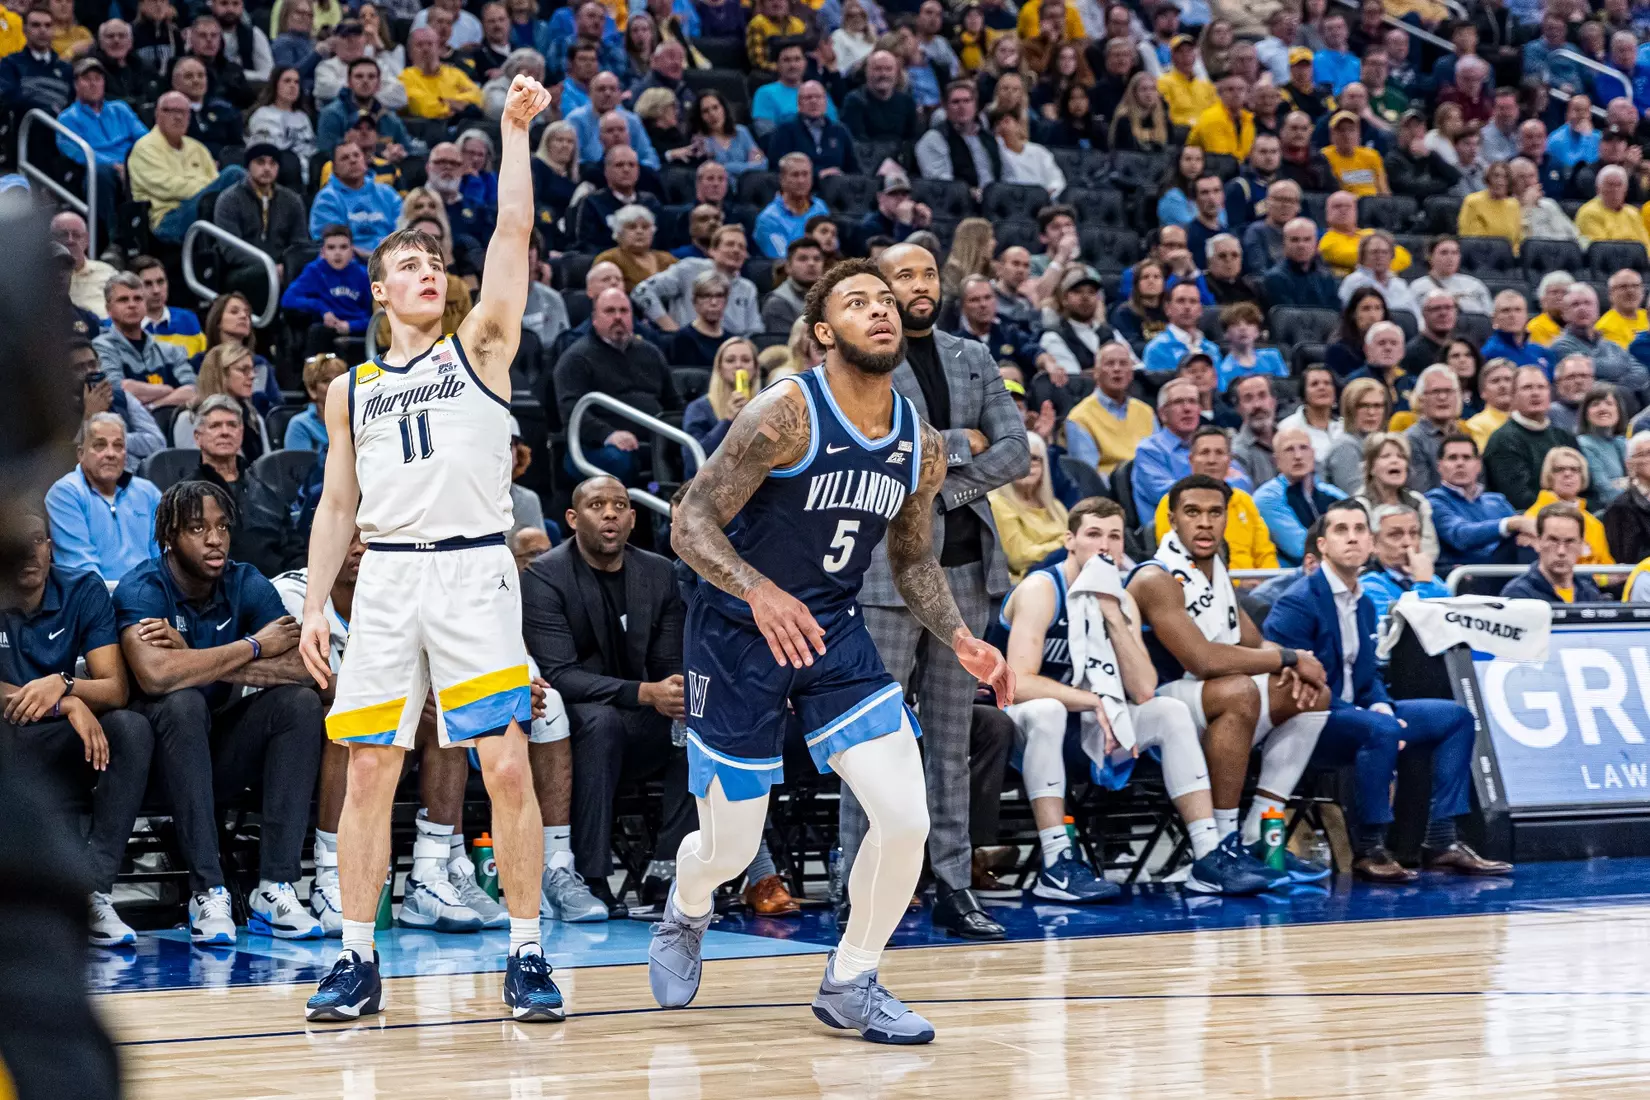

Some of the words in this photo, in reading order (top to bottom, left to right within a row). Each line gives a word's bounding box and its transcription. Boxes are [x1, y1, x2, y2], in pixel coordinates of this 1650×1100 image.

[362, 374, 466, 426] Marquette
[398, 409, 435, 464] 11
[822, 519, 861, 573] 5
[688, 670, 711, 718] V
[1580, 763, 1649, 790] LAW
[1265, 828, 1283, 847] G
